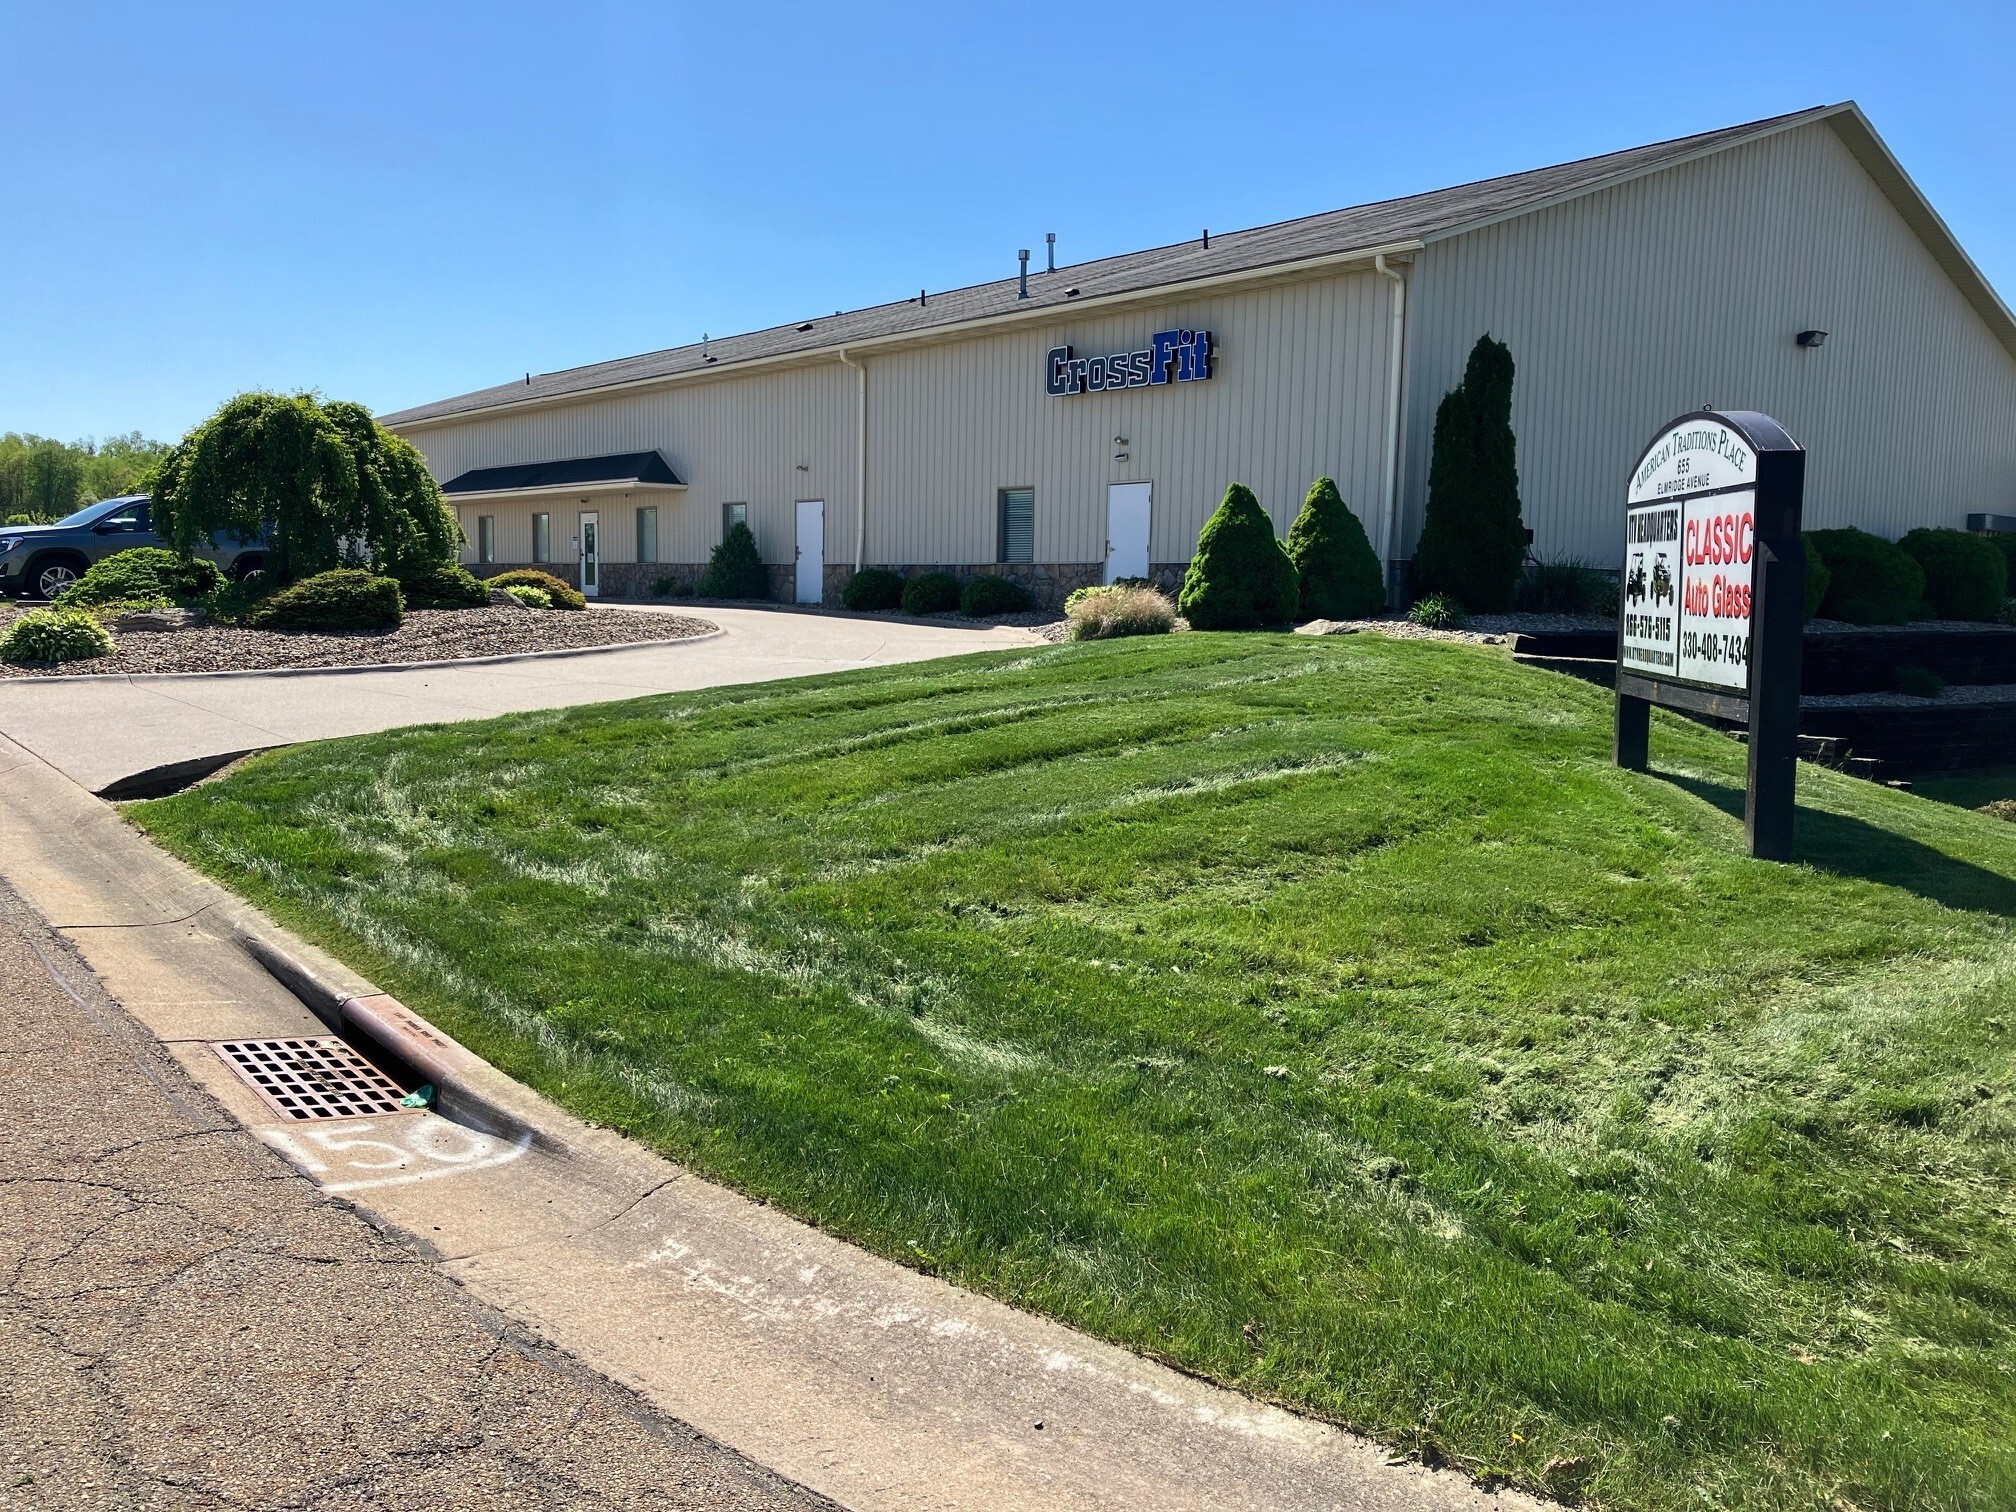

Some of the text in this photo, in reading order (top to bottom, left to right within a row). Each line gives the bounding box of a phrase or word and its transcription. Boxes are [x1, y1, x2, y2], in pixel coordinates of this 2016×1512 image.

[1045, 328, 1213, 397] CrossFit
[1635, 428, 1747, 494] AMERICAN TRADITIONS PLACE
[1677, 457, 1690, 475] 655
[1657, 473, 1710, 495] ELMRIDGE AVENUE
[1686, 512, 1753, 566] CLASSIC
[1684, 574, 1751, 619] Auto Glass
[1682, 631, 1750, 666] 330-408-7434
